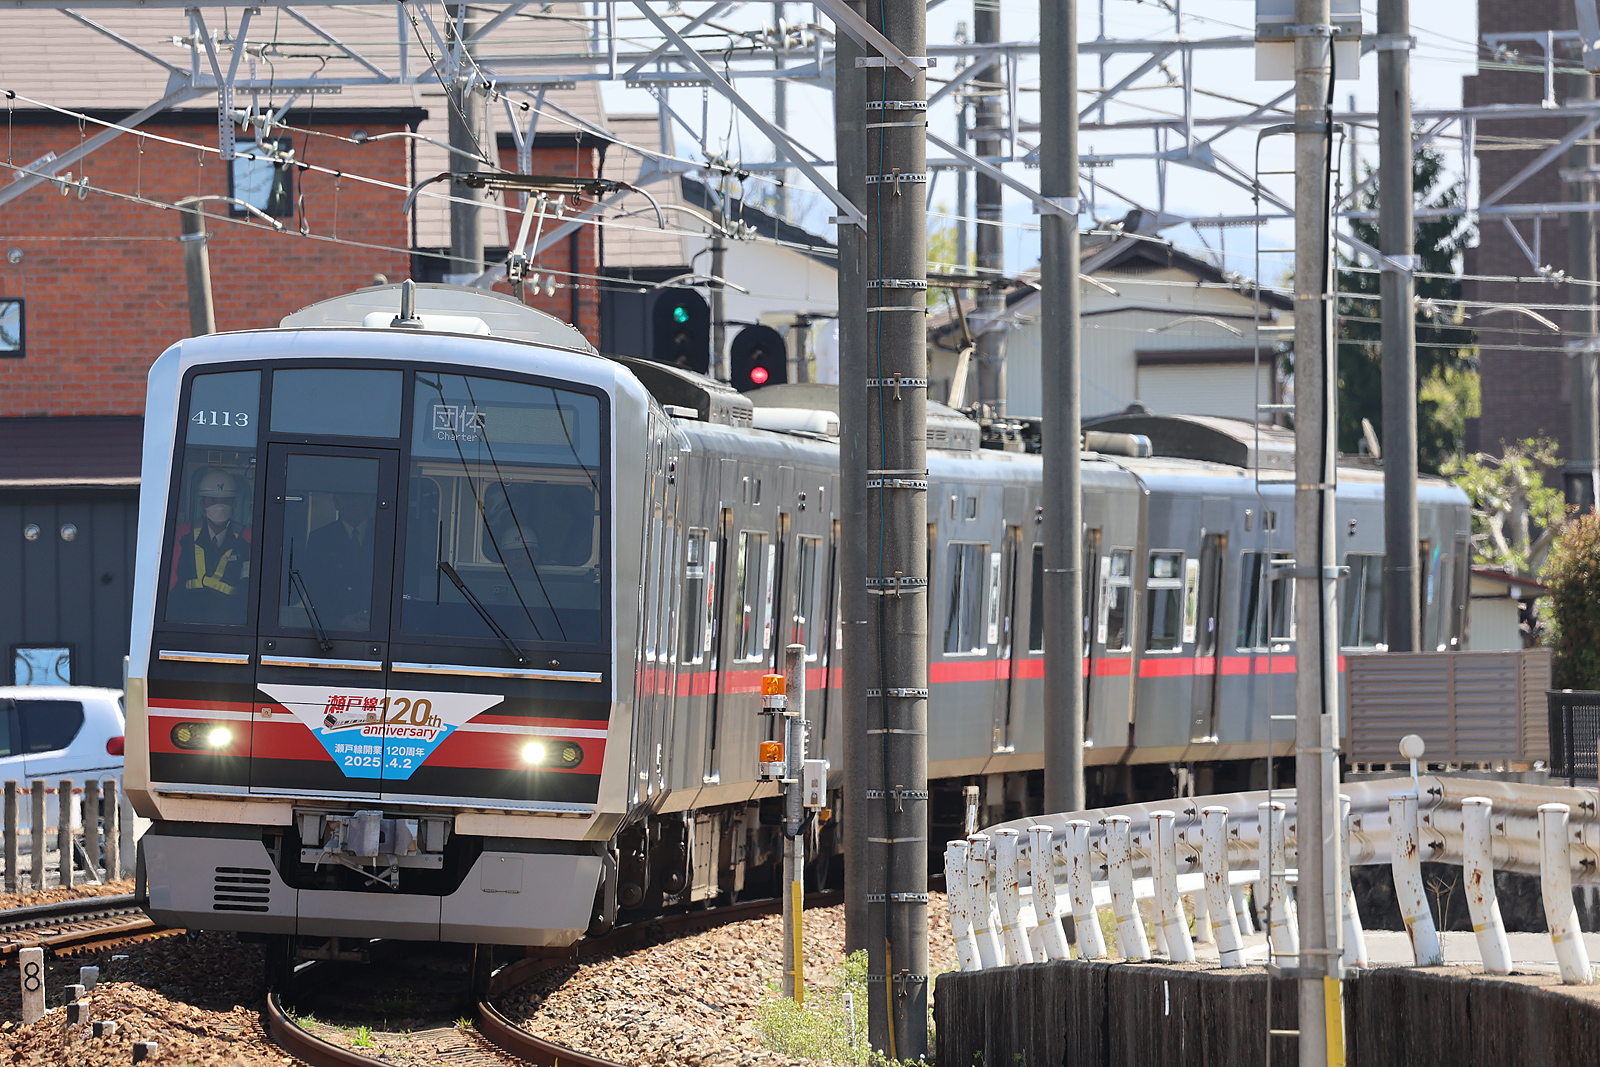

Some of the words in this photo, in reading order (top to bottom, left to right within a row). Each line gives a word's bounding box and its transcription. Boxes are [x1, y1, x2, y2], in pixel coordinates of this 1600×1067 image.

[191, 410, 249, 427] 4113
[433, 404, 486, 433] 団体
[437, 431, 478, 442] Charter
[324, 694, 379, 714] 瀬戸線
[363, 725, 437, 739] anniversary
[25, 962, 40, 991] 8
